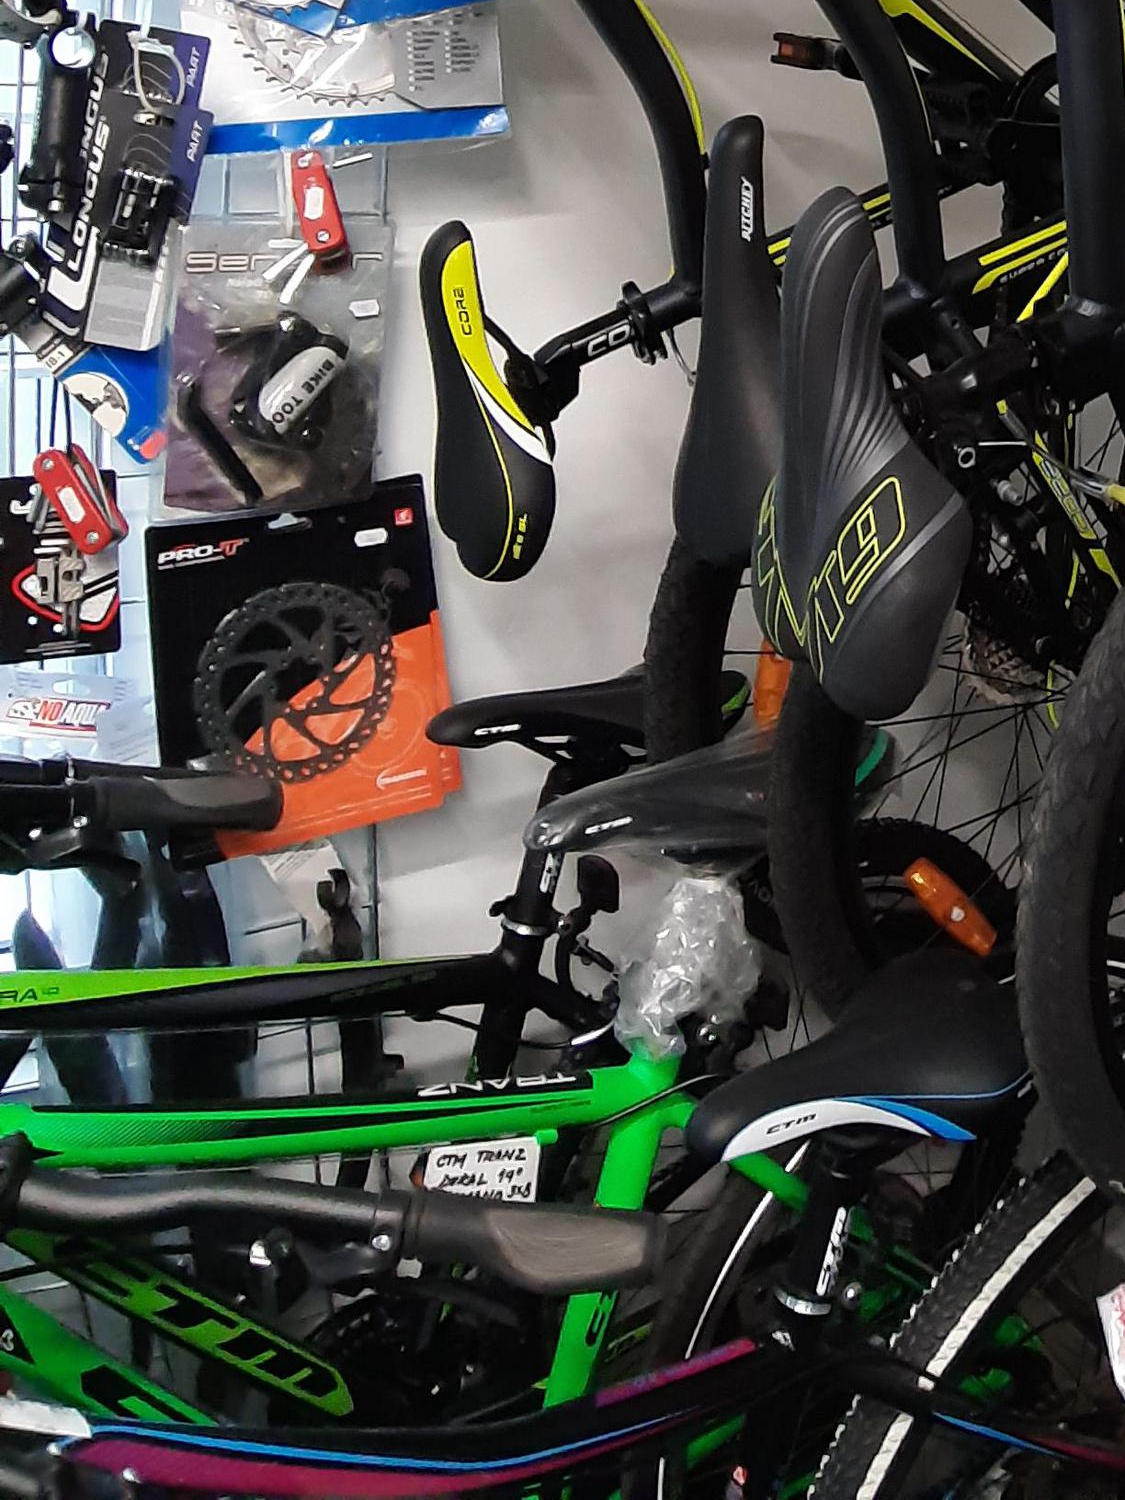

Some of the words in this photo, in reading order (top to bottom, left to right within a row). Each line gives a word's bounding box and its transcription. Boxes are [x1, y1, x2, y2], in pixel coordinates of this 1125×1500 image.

[452, 286, 472, 336] CORE
[301, 359, 336, 394] BIKE
[765, 1113, 818, 1135] CTM
